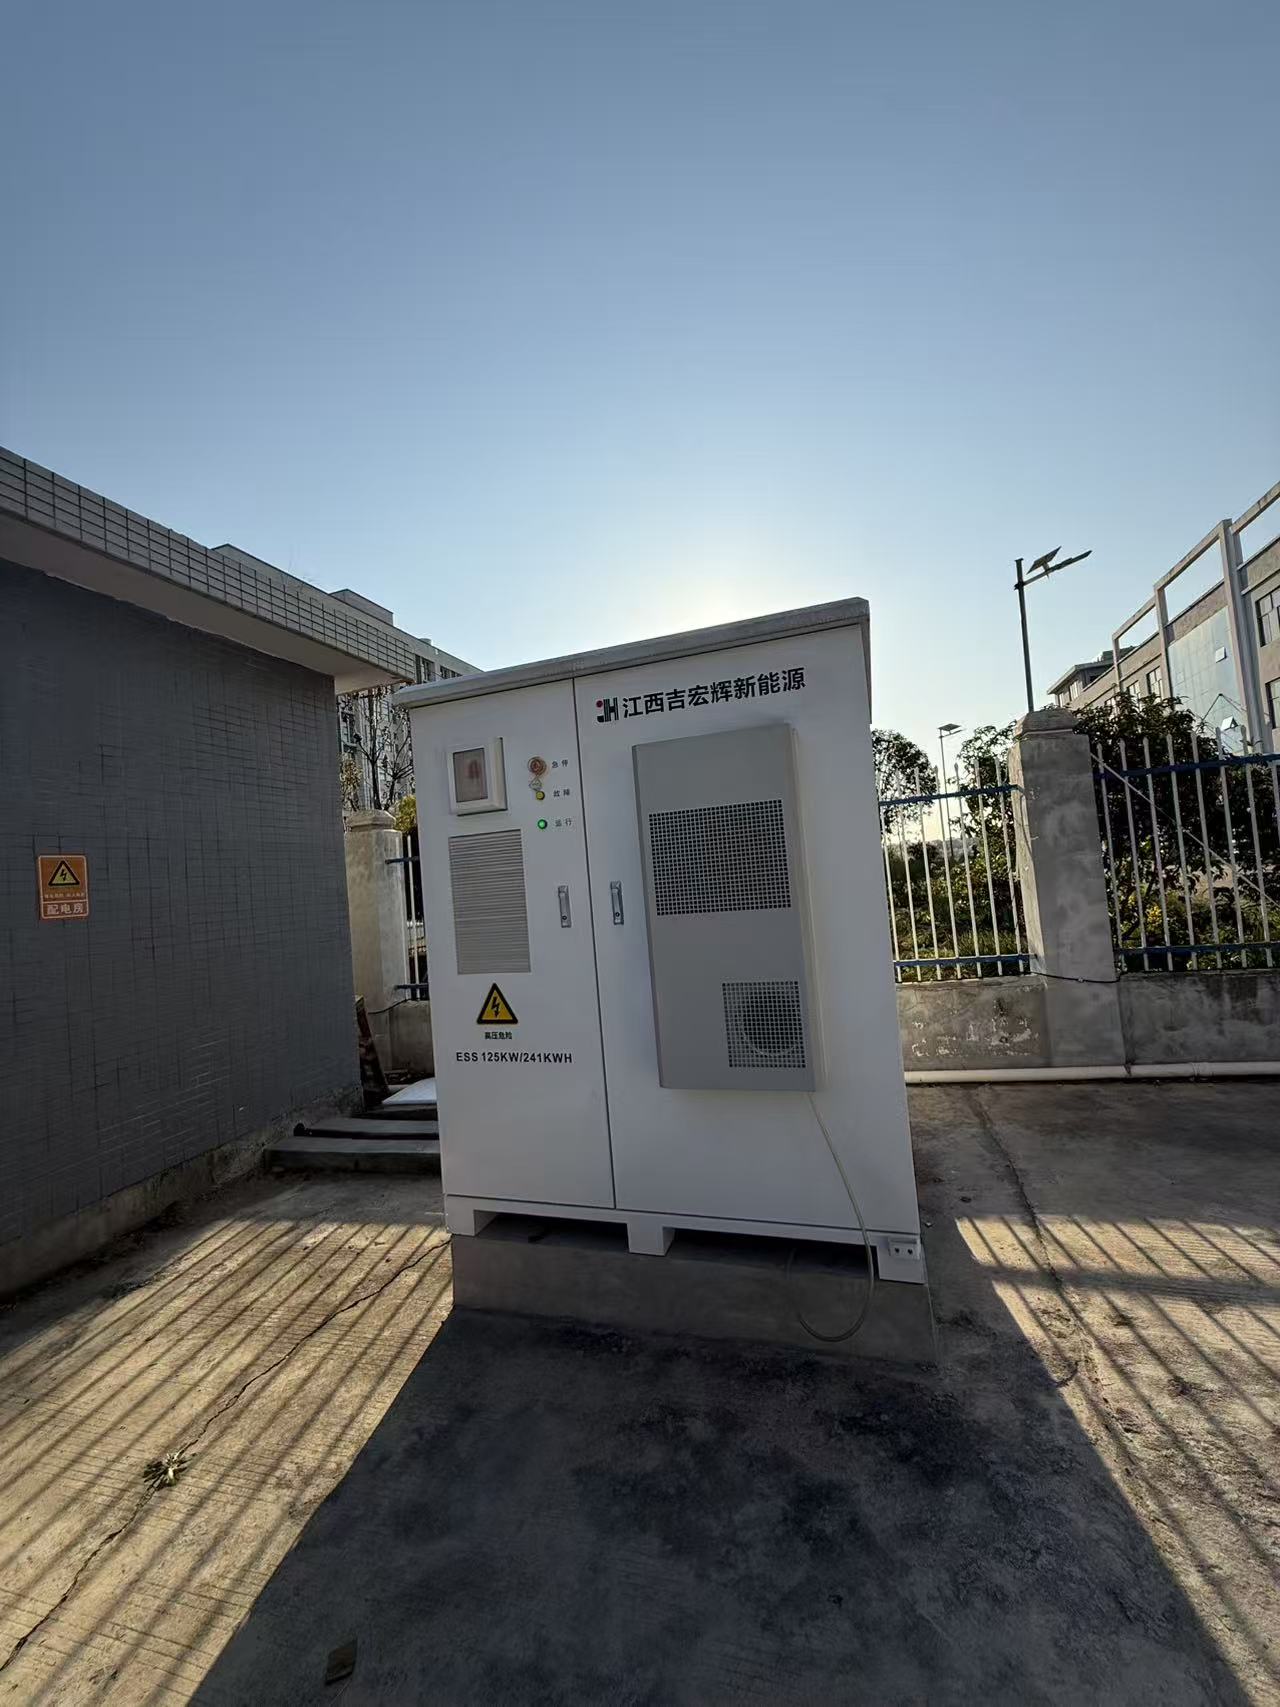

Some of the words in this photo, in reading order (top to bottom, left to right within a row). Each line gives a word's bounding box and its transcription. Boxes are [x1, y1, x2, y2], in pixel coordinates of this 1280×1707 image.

[622, 667, 806, 719] 江西吉宏辉新能源
[47, 903, 83, 915] 配电房
[484, 1031, 513, 1040] 高压危险
[456, 1052, 478, 1062] ESS
[481, 1052, 573, 1063] 125KW/241KWH
